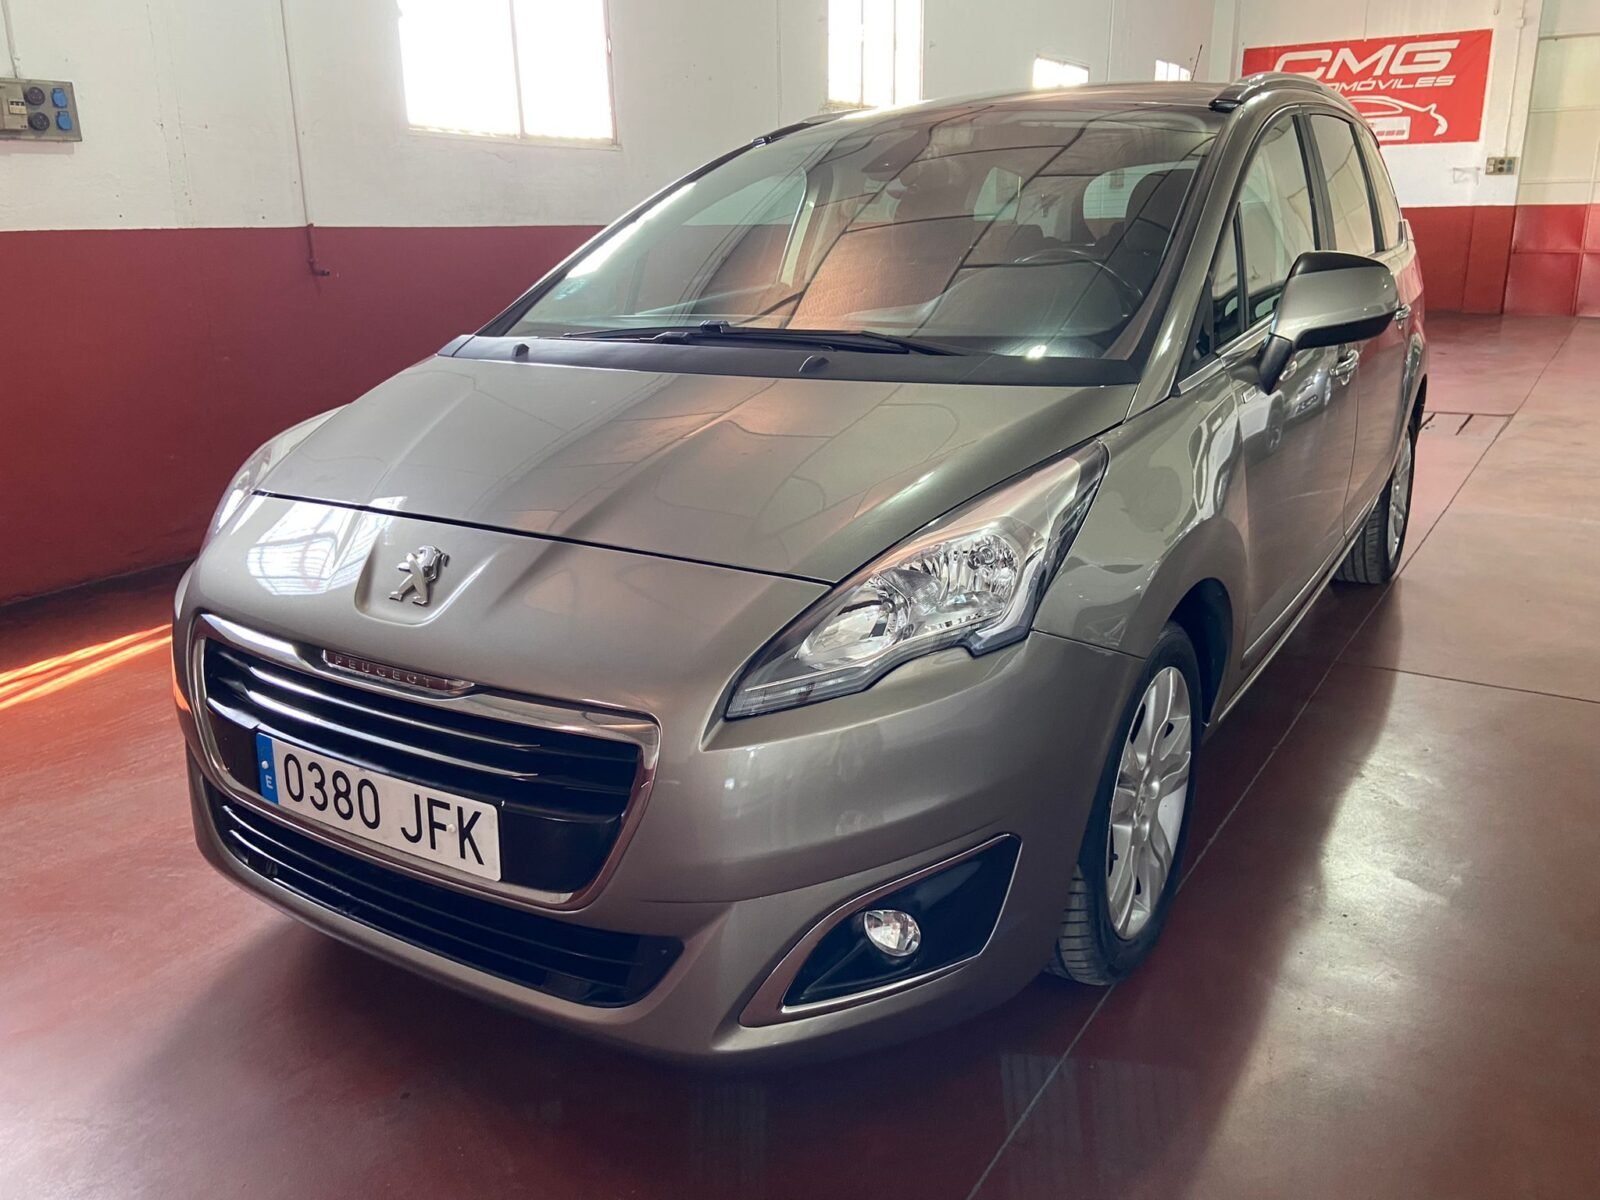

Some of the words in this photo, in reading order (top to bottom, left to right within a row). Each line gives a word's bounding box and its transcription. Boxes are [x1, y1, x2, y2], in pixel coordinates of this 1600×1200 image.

[1273, 40, 1460, 80] CMG
[1325, 75, 1456, 92] OMÓVILES
[334, 655, 431, 688] PEUGEOT
[265, 774, 274, 790] E
[284, 753, 381, 830] 0380
[400, 793, 485, 866] JFK
